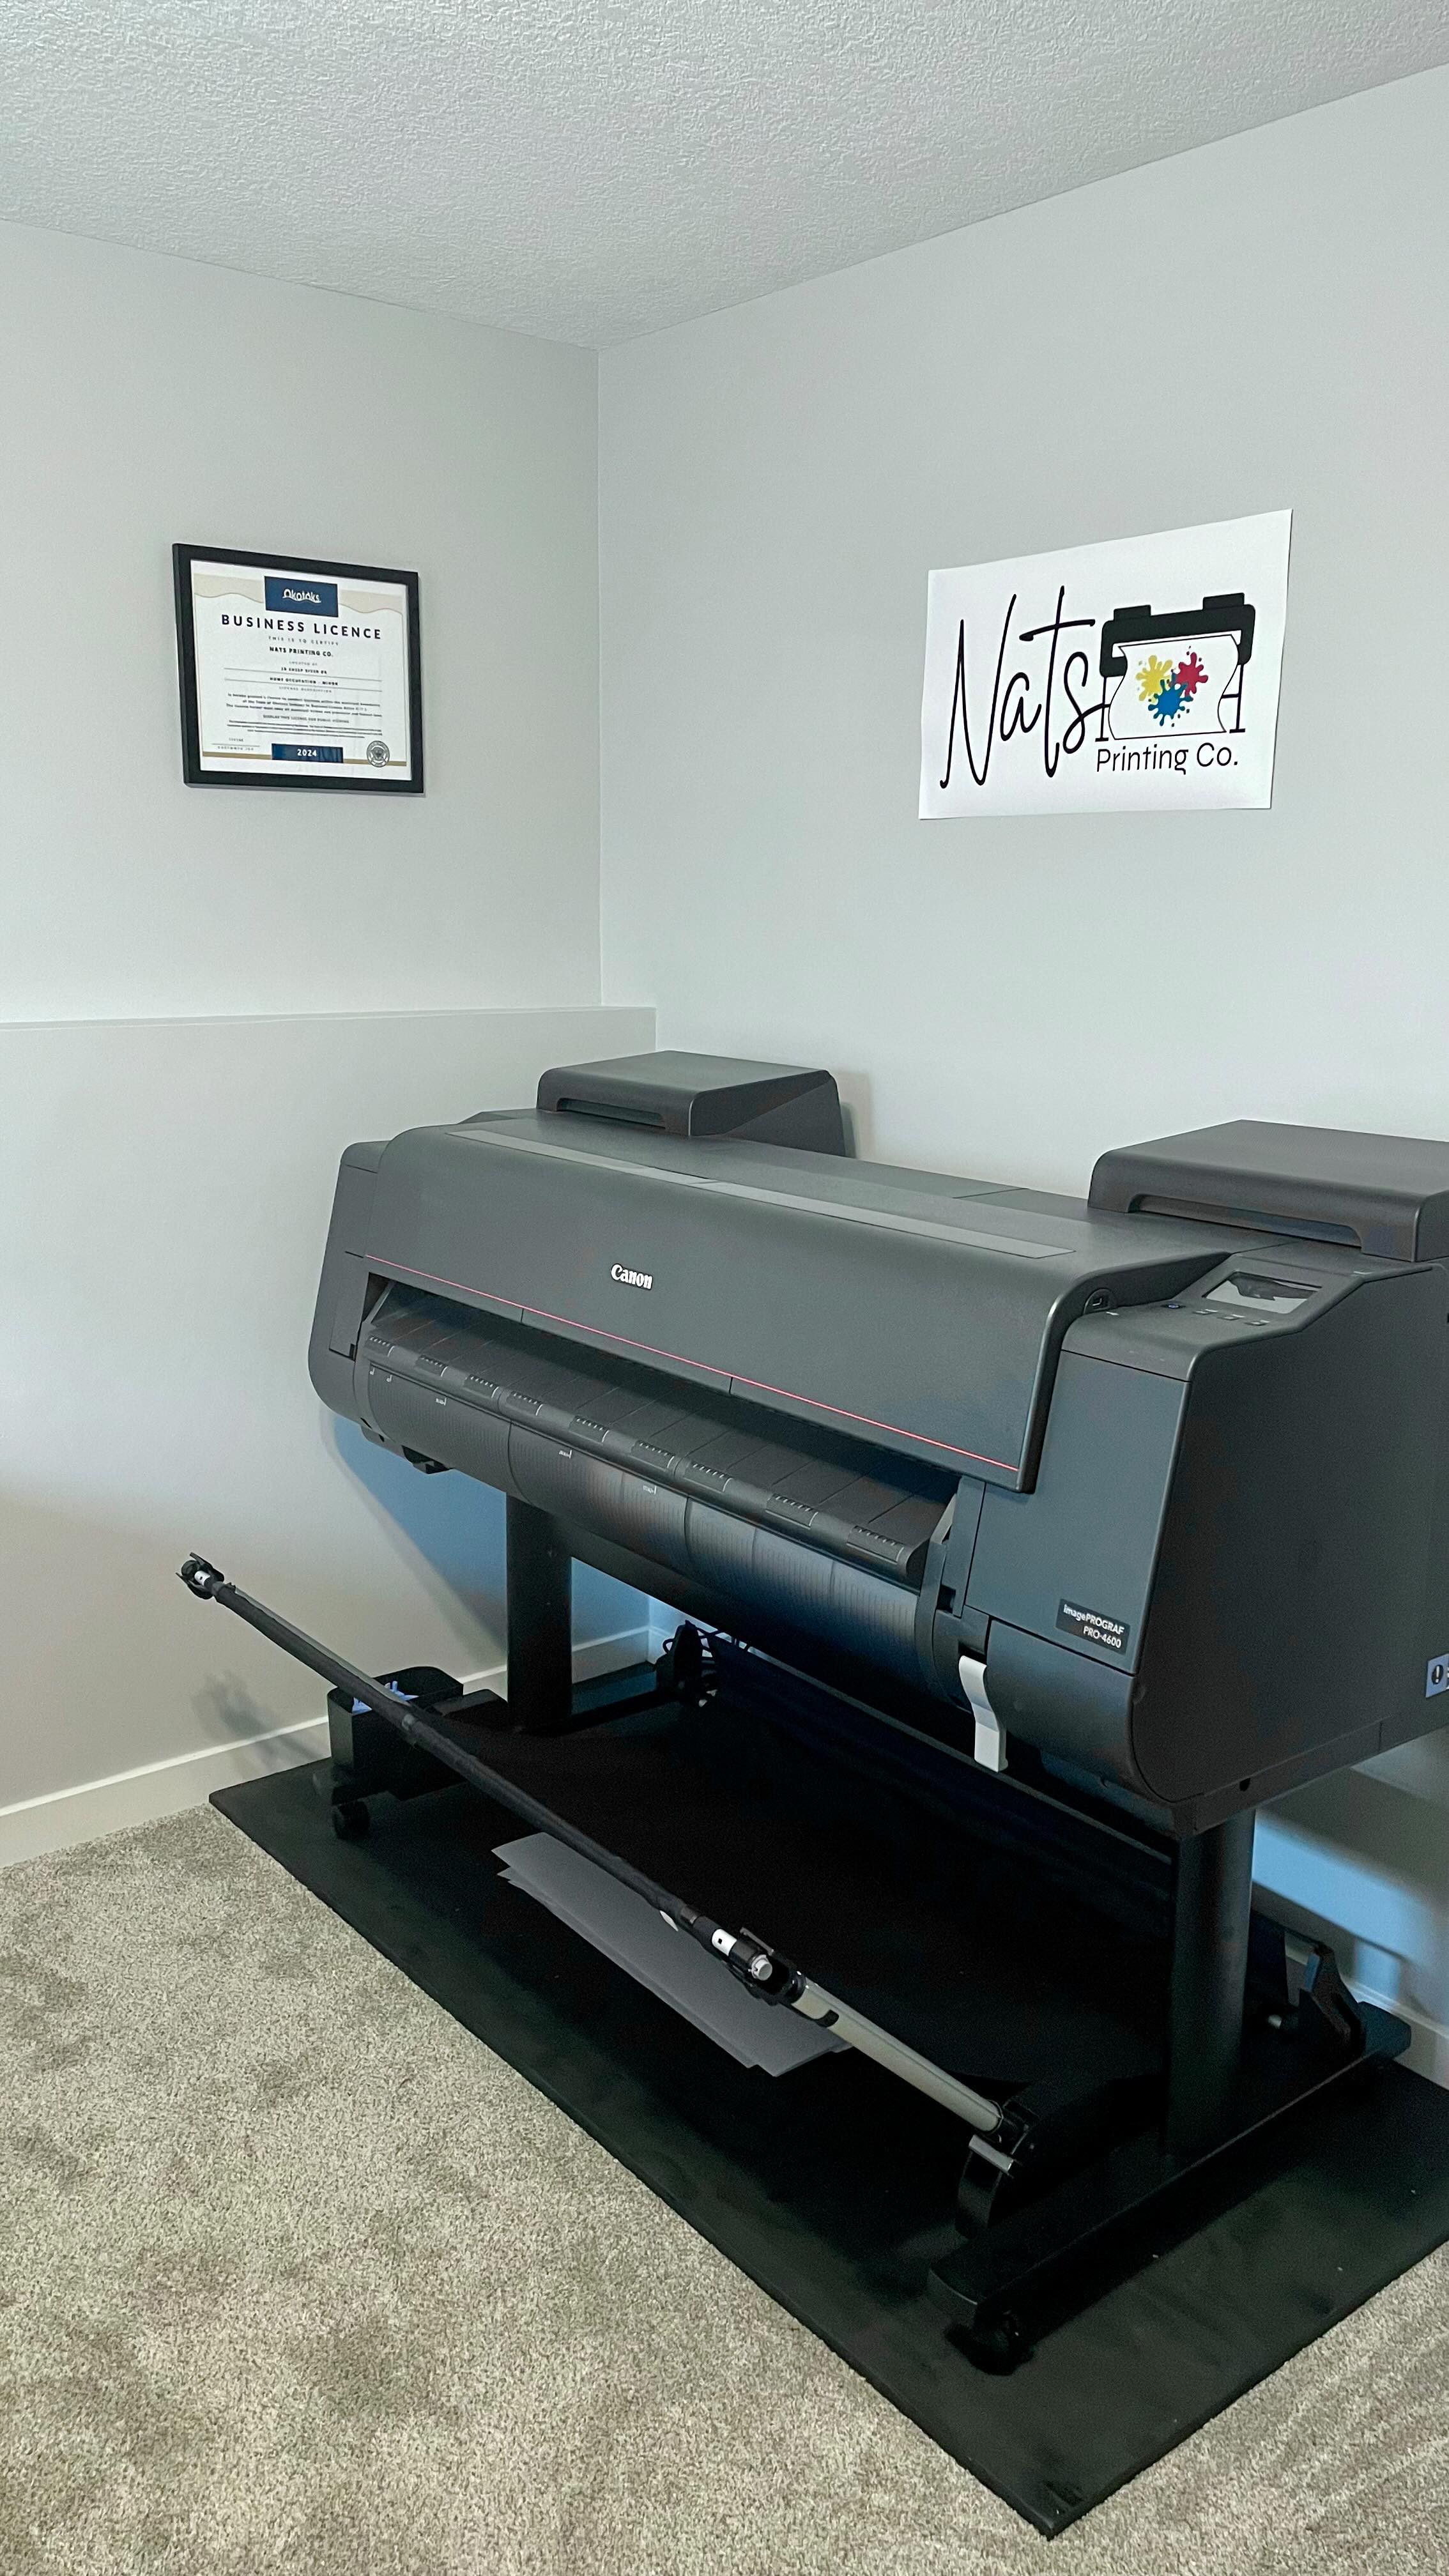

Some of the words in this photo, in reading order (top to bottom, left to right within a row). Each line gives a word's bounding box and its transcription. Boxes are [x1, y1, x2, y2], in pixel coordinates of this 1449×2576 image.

[221, 614, 305, 632] BUSINESS
[314, 623, 381, 640] LICENCE
[289, 648, 320, 656] PRINTING
[940, 585, 1110, 788] Nats
[296, 748, 317, 757] 2024
[1096, 743, 1189, 775] Printing
[1196, 742, 1239, 767] Co.
[611, 1264, 653, 1290] Canon
[1062, 1603, 1125, 1635] imagePROGRAF
[1083, 1625, 1122, 1648] PRO-4600
